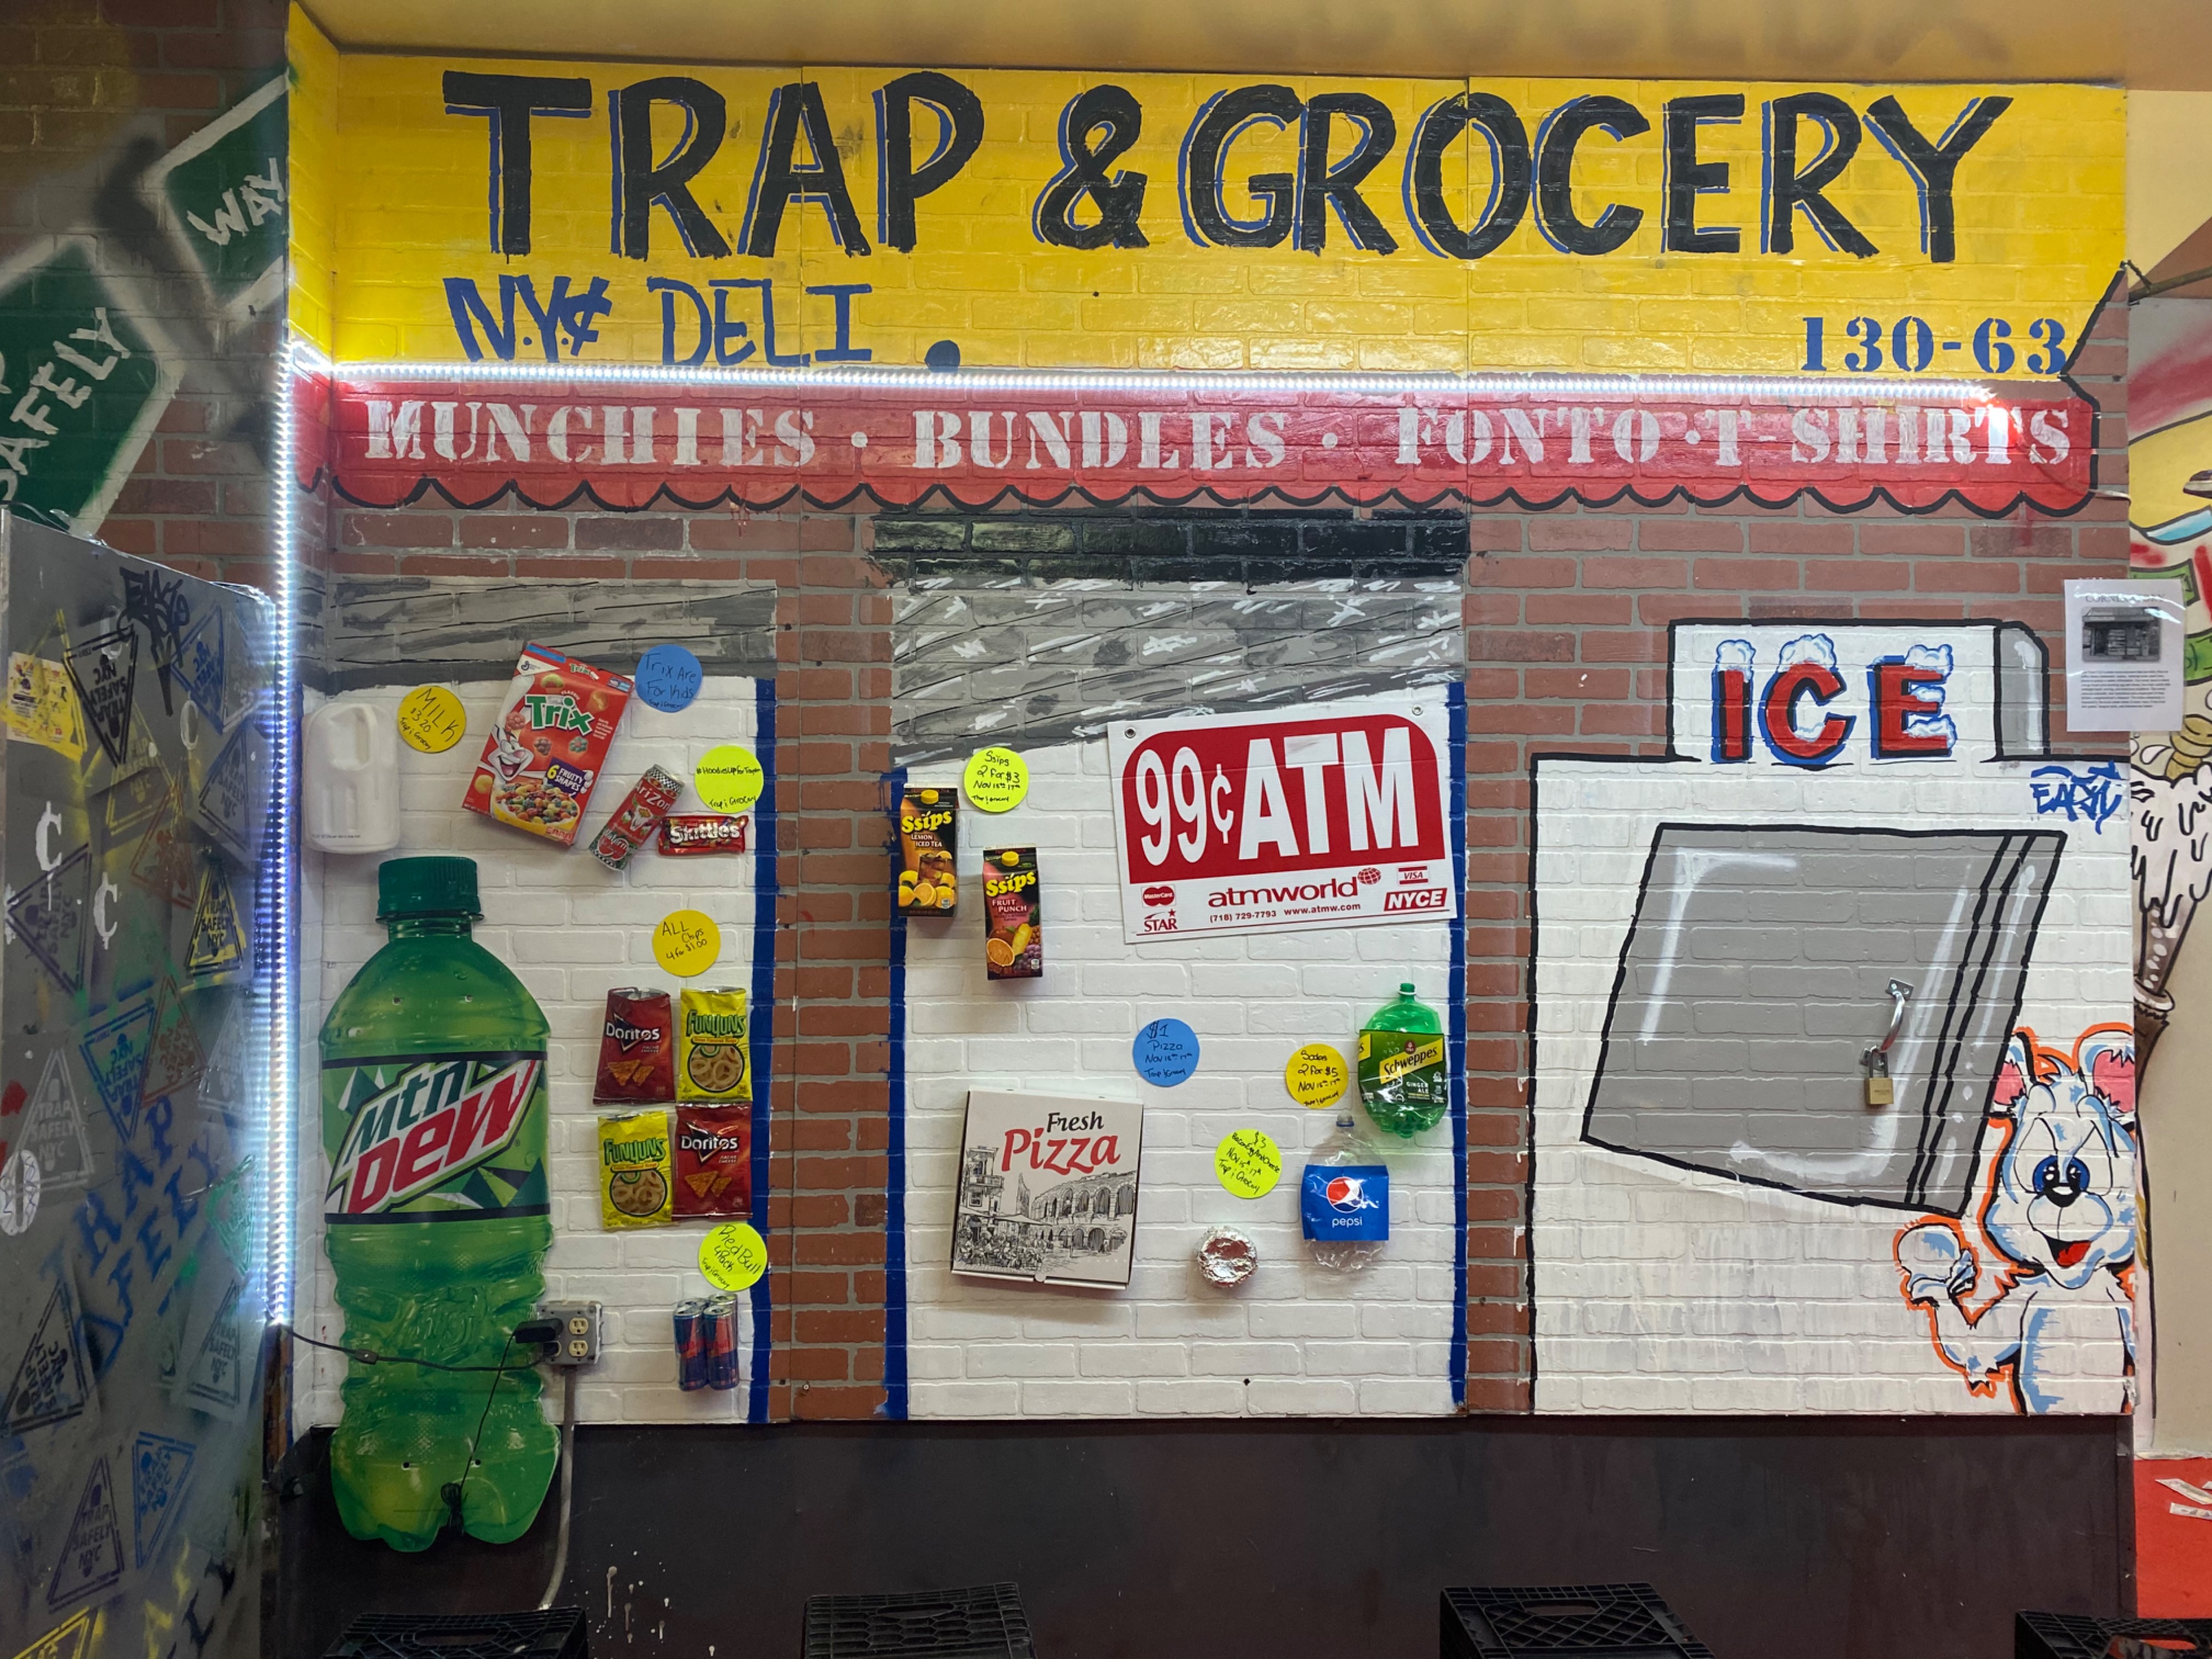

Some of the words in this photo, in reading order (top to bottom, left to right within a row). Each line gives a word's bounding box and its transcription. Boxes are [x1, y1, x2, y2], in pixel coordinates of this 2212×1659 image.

[442, 70, 983, 263] TRAP
[1032, 85, 1150, 249] &
[1178, 84, 2013, 263] GROCERY
[186, 158, 285, 246] WAY
[646, 275, 872, 367] DELI
[1800, 315, 2067, 374] 130-63
[364, 400, 816, 467] MUNCHIES
[912, 410, 1287, 470] BUNDLES
[1395, 407, 1660, 466] FONTO
[644, 653, 673, 679] Trix
[677, 666, 697, 684] Are
[647, 679, 666, 697] For
[1711, 641, 1957, 765] ICE
[416, 688, 458, 742] MILK
[526, 695, 595, 736] Trix
[547, 764, 560, 780] 6
[559, 768, 583, 784] FRUITY
[554, 774, 581, 791] SHAPES
[977, 765, 988, 778] 2
[1005, 771, 1020, 784] $3
[1135, 747, 1234, 866] 99¢
[1238, 727, 1420, 860] ATM
[902, 810, 953, 833] Ssips
[670, 822, 741, 844] Skittles
[985, 871, 1036, 898] Ssips
[1402, 871, 1424, 881] VISA
[1143, 891, 1173, 900] MasterCard
[1208, 877, 1359, 907] atmworld
[1386, 889, 1444, 909] NYCE
[998, 905, 1027, 913] PUNCH
[1209, 913, 1233, 923] (718)
[1235, 910, 1277, 921] 729-7793
[1284, 902, 1361, 916] www.atmw.com
[662, 921, 690, 936] ALL
[1144, 917, 1178, 933] STAR
[606, 1022, 660, 1040] Doritos
[1146, 1020, 1169, 1039] $1
[1145, 1053, 1162, 1063] Nov
[1384, 1046, 1438, 1080] Schweppes
[1297, 1063, 1309, 1077] 2
[1324, 1066, 1338, 1078] $5
[36, 1099, 71, 1120] TRAP
[342, 1061, 469, 1167] Mtn
[29, 1120, 75, 1143] SAFELY
[1046, 1111, 1104, 1133] Fresh
[39, 1140, 65, 1161] NYC
[681, 1135, 739, 1150] Doritos
[1001, 1128, 1121, 1176] Pizza
[1332, 1217, 1363, 1228] pepsi
[737, 1248, 762, 1275] Bull
